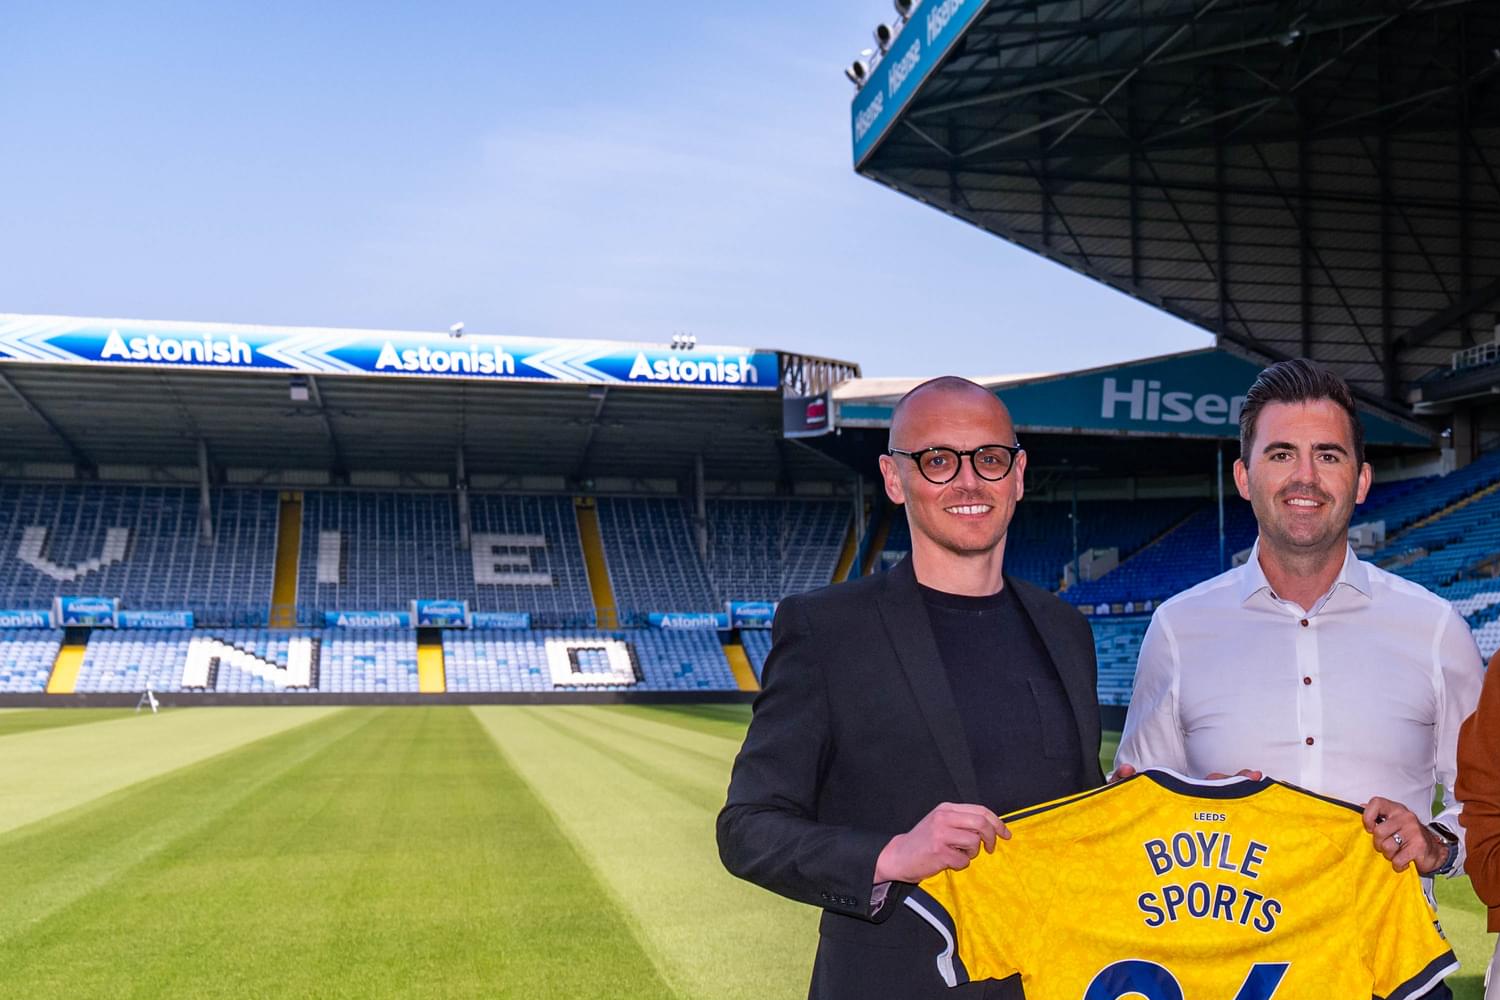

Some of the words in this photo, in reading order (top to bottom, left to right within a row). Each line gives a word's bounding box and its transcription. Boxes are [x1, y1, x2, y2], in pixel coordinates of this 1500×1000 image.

[100, 328, 252, 364] Astonish
[375, 341, 515, 375] Astonish
[628, 351, 758, 384] Astonish
[0, 612, 44, 628] onish
[336, 612, 401, 628] Astonish
[660, 614, 719, 629] Astonish
[1193, 811, 1227, 823] LEEDS
[1143, 830, 1269, 880] BOYLE
[1136, 881, 1282, 934] SPORTS
